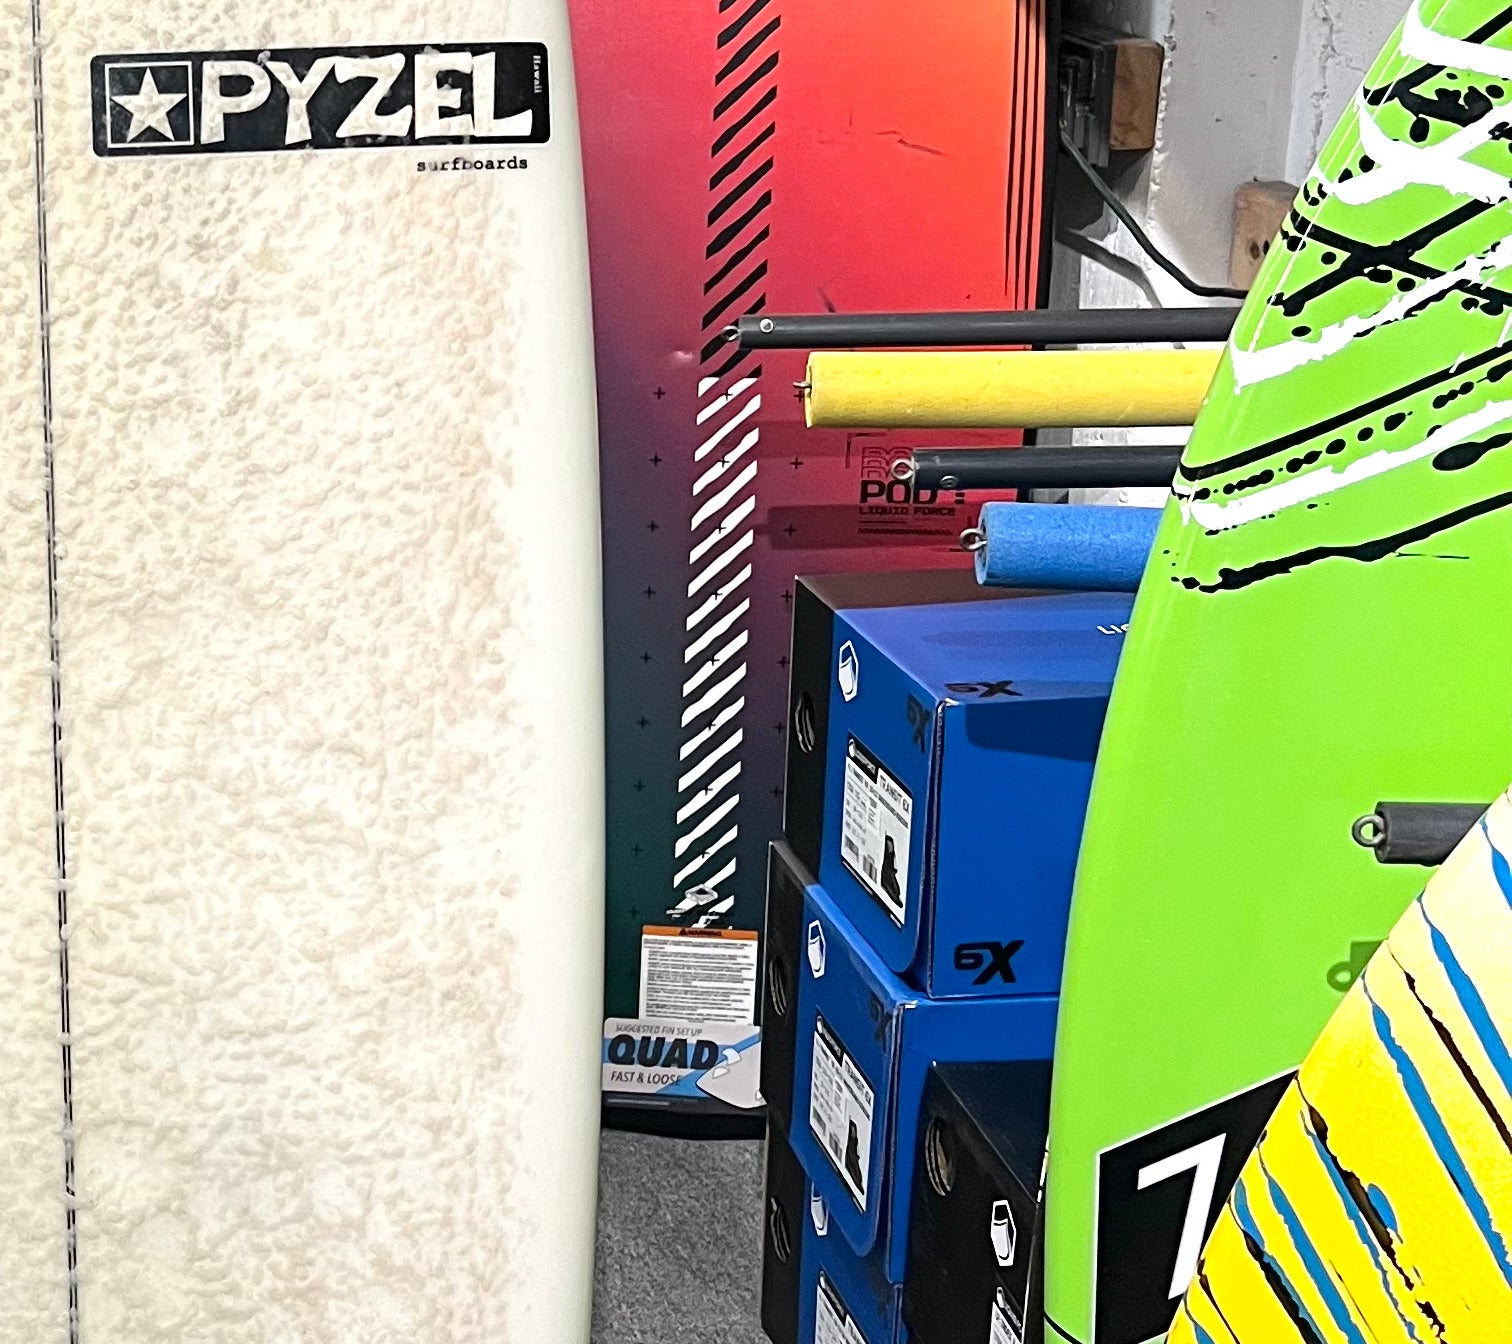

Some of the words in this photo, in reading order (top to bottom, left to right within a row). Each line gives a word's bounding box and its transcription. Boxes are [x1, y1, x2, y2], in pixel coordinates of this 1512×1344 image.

[200, 51, 533, 145] PYZEL
[416, 155, 528, 172] surfboards
[859, 505, 909, 516] LIQUID
[913, 506, 956, 517] FORCE
[953, 939, 1025, 986] 6X
[615, 1022, 660, 1034] SUGGESTED
[661, 1026, 676, 1035] FIN
[607, 1034, 719, 1070] QUAD
[610, 1069, 636, 1083] FAST
[637, 1072, 645, 1084] &
[646, 1072, 682, 1087] LOOSE
[1137, 1132, 1227, 1300] 7
